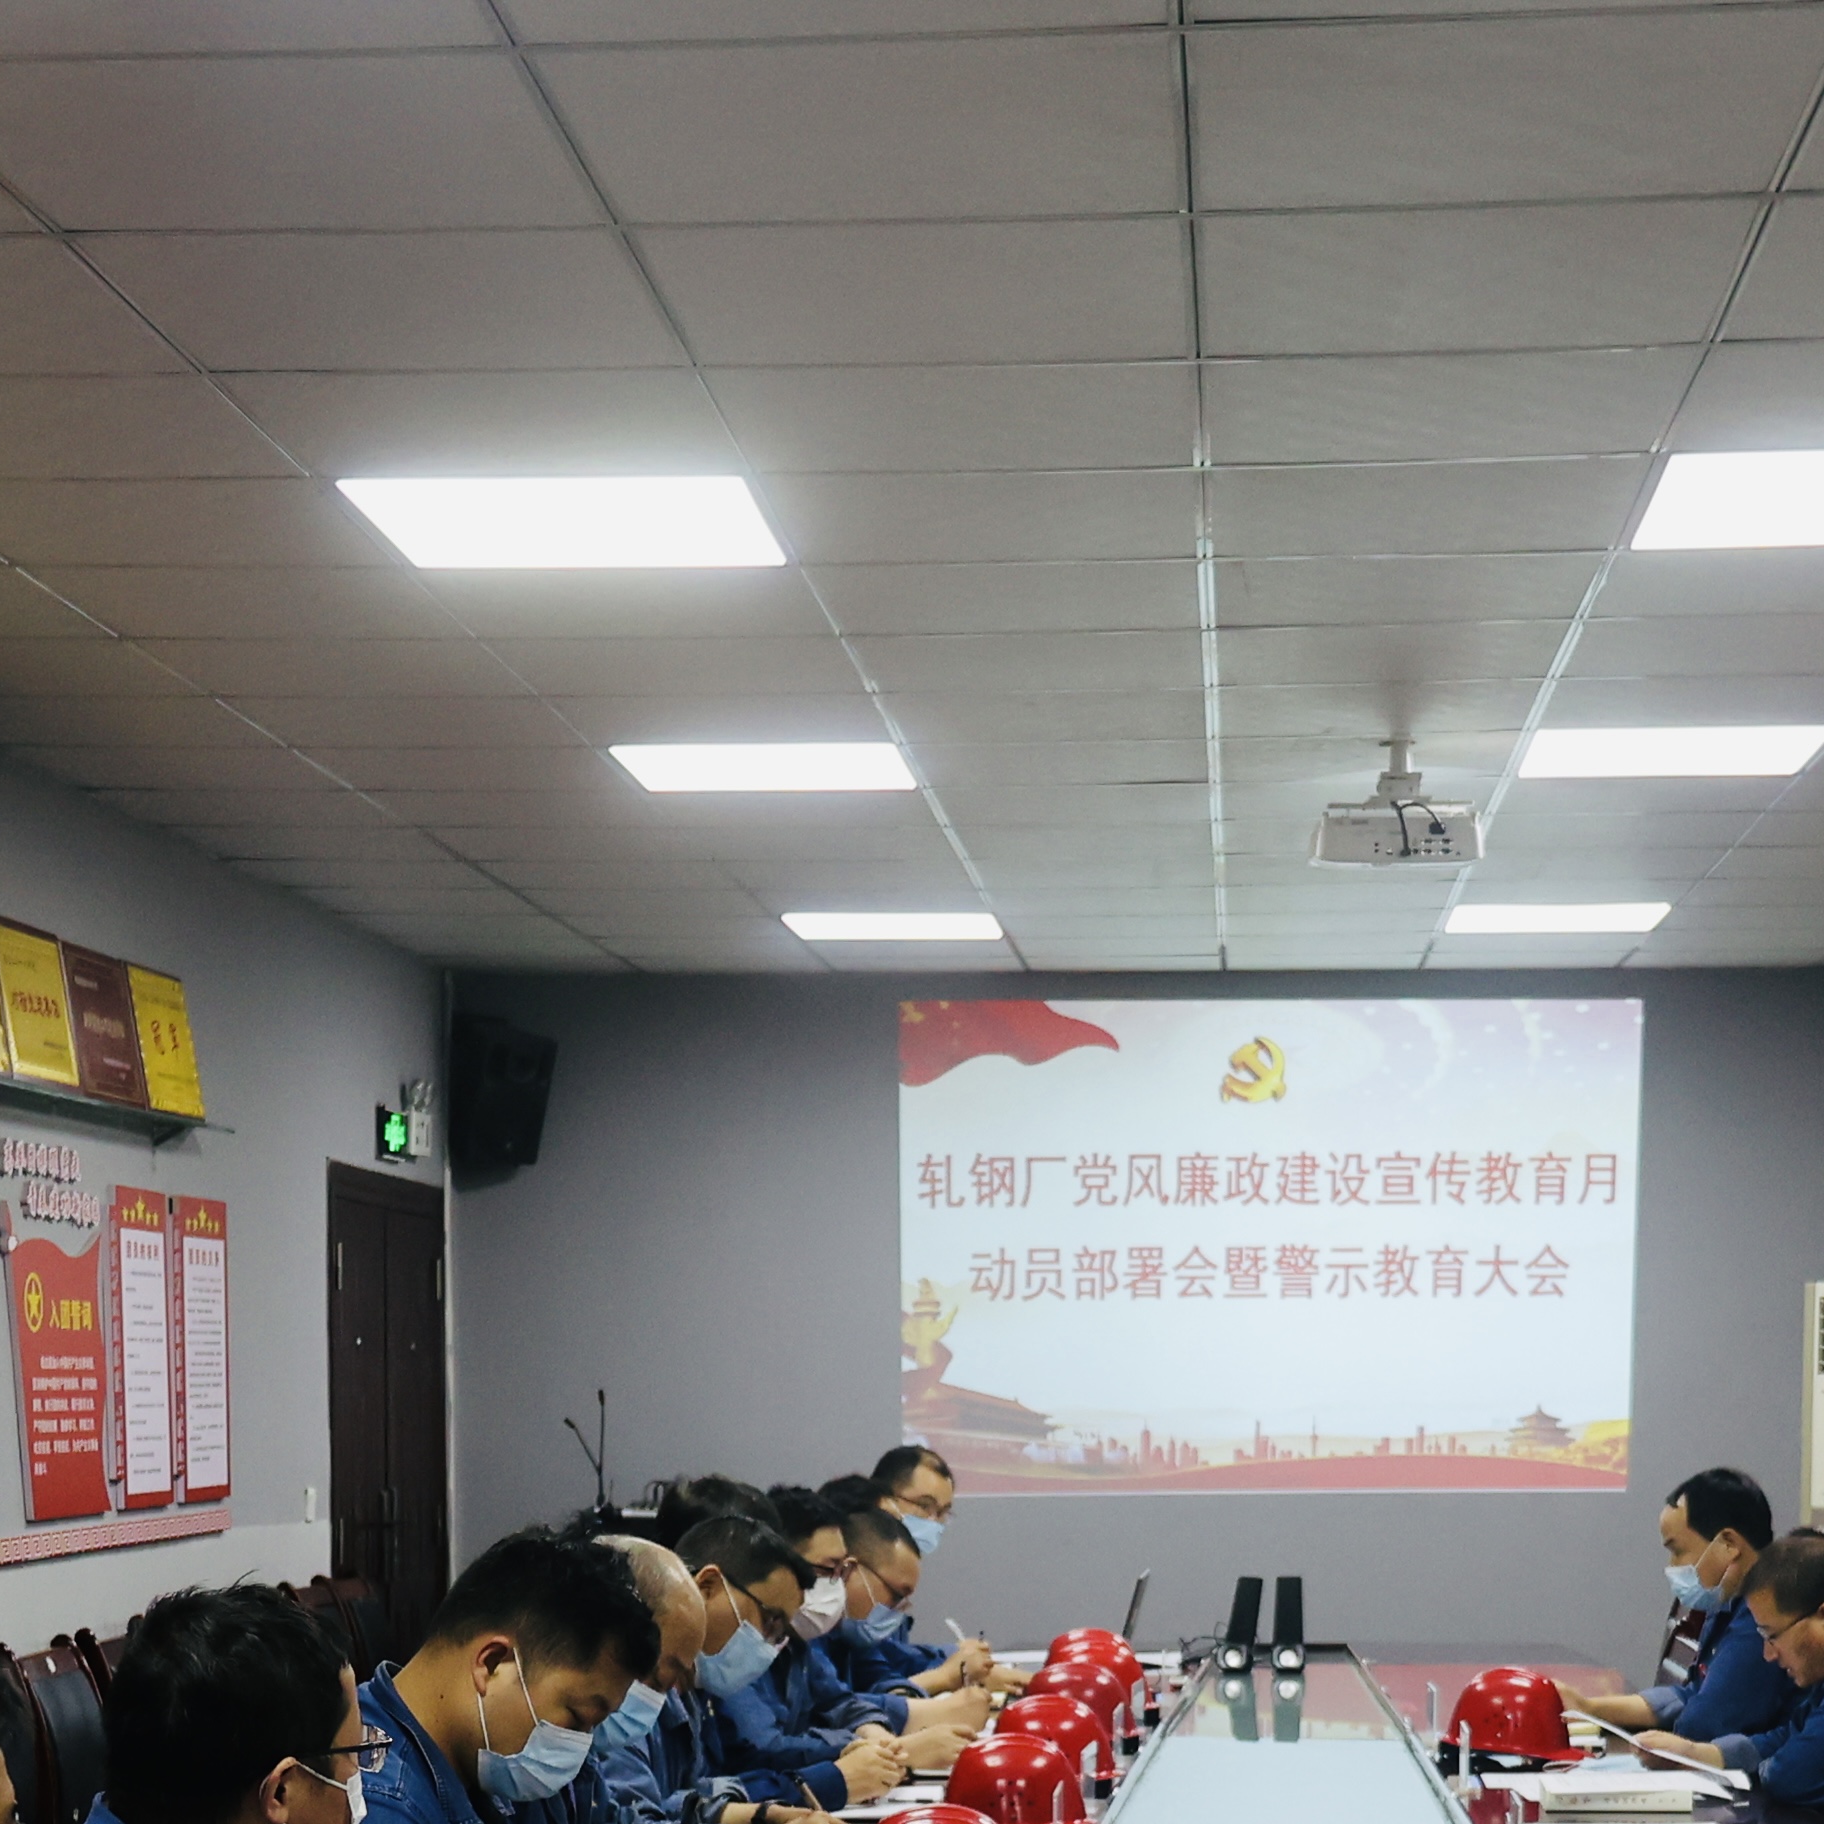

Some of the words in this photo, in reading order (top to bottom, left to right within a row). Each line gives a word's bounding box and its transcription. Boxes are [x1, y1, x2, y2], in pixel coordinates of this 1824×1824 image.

[915, 1149, 1621, 1209] 轧钢厂党风廉政建设宣传教育月
[968, 1242, 1572, 1303] 动员部署会暨警示教育大会
